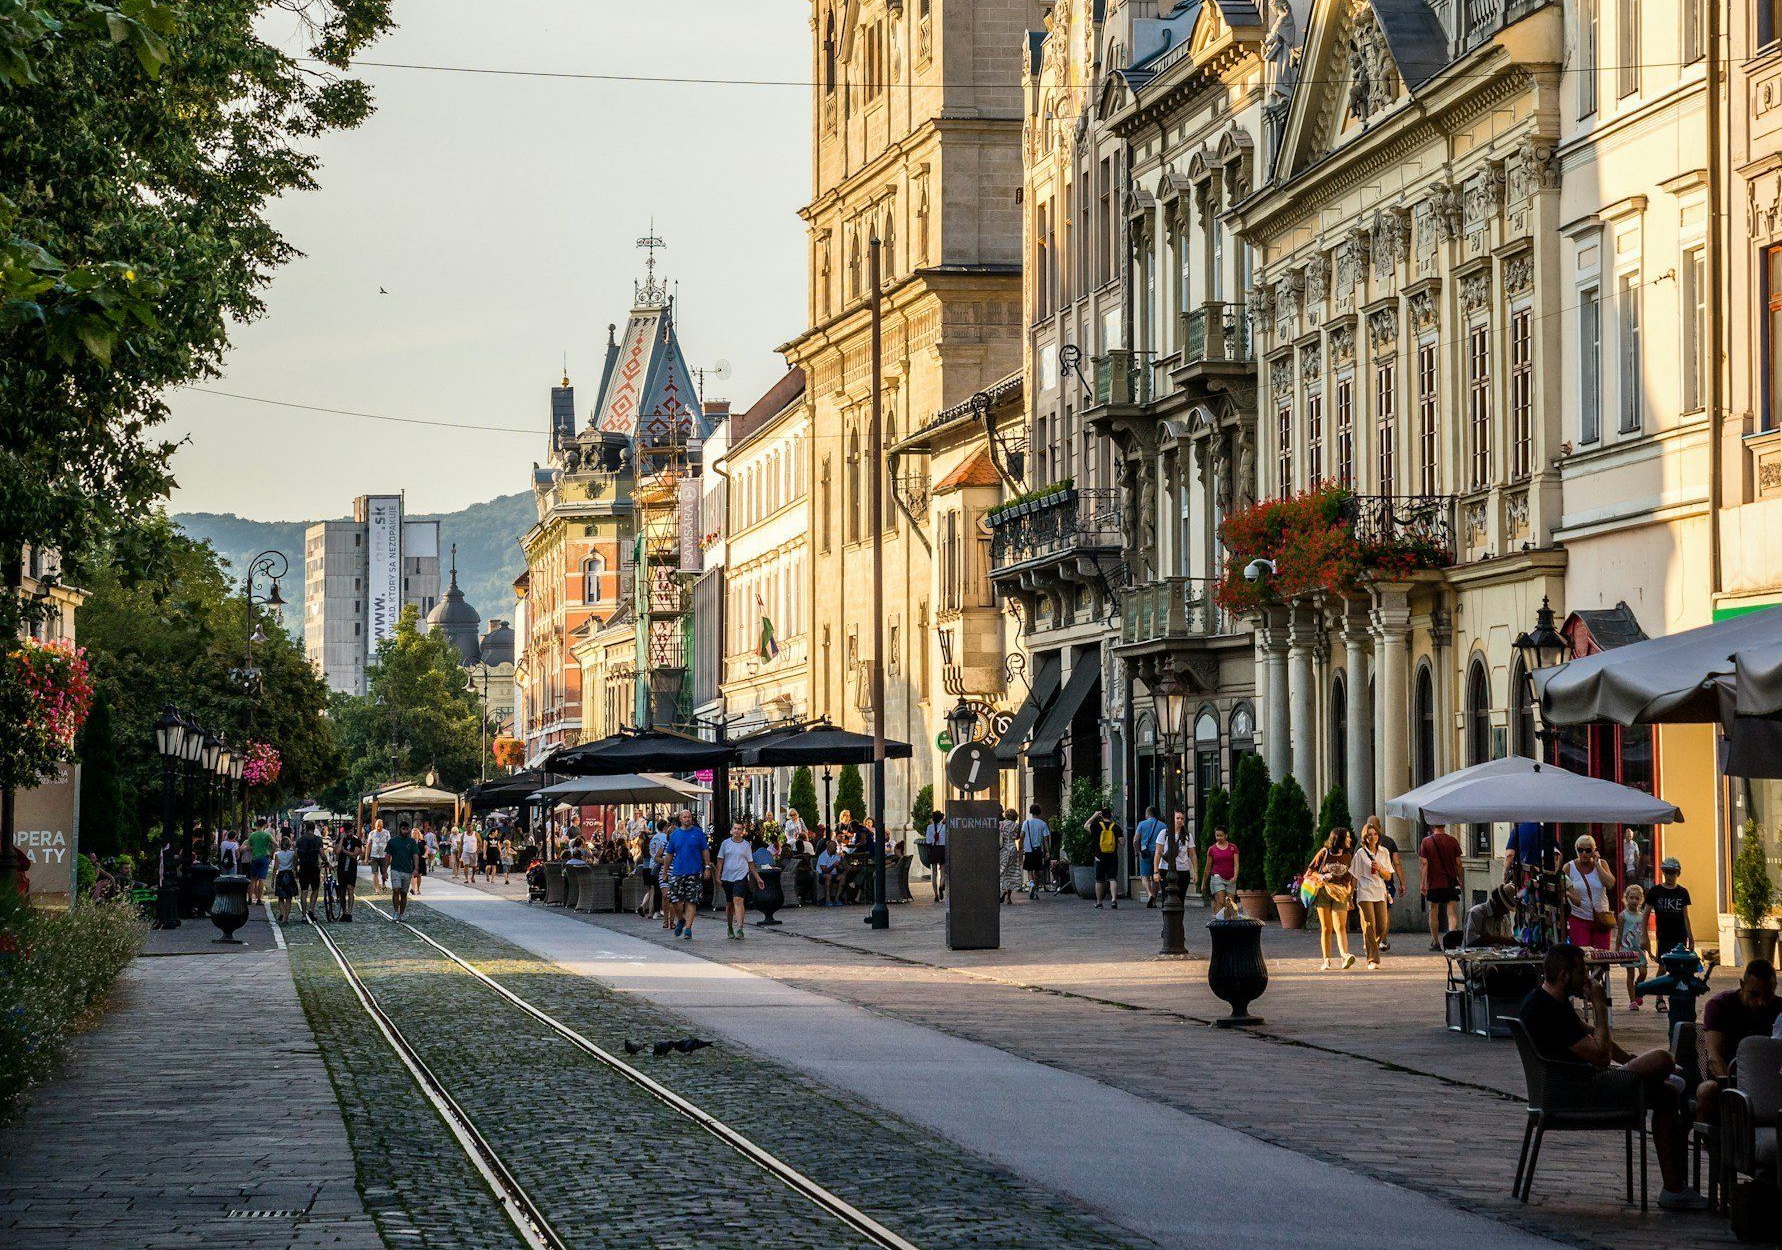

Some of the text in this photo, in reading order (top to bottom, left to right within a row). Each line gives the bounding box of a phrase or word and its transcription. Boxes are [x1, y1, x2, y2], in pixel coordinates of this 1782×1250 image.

[388, 505, 397, 558] NEZOPAKUJE
[388, 561, 396, 572] SA
[26, 848, 66, 864] A TY
